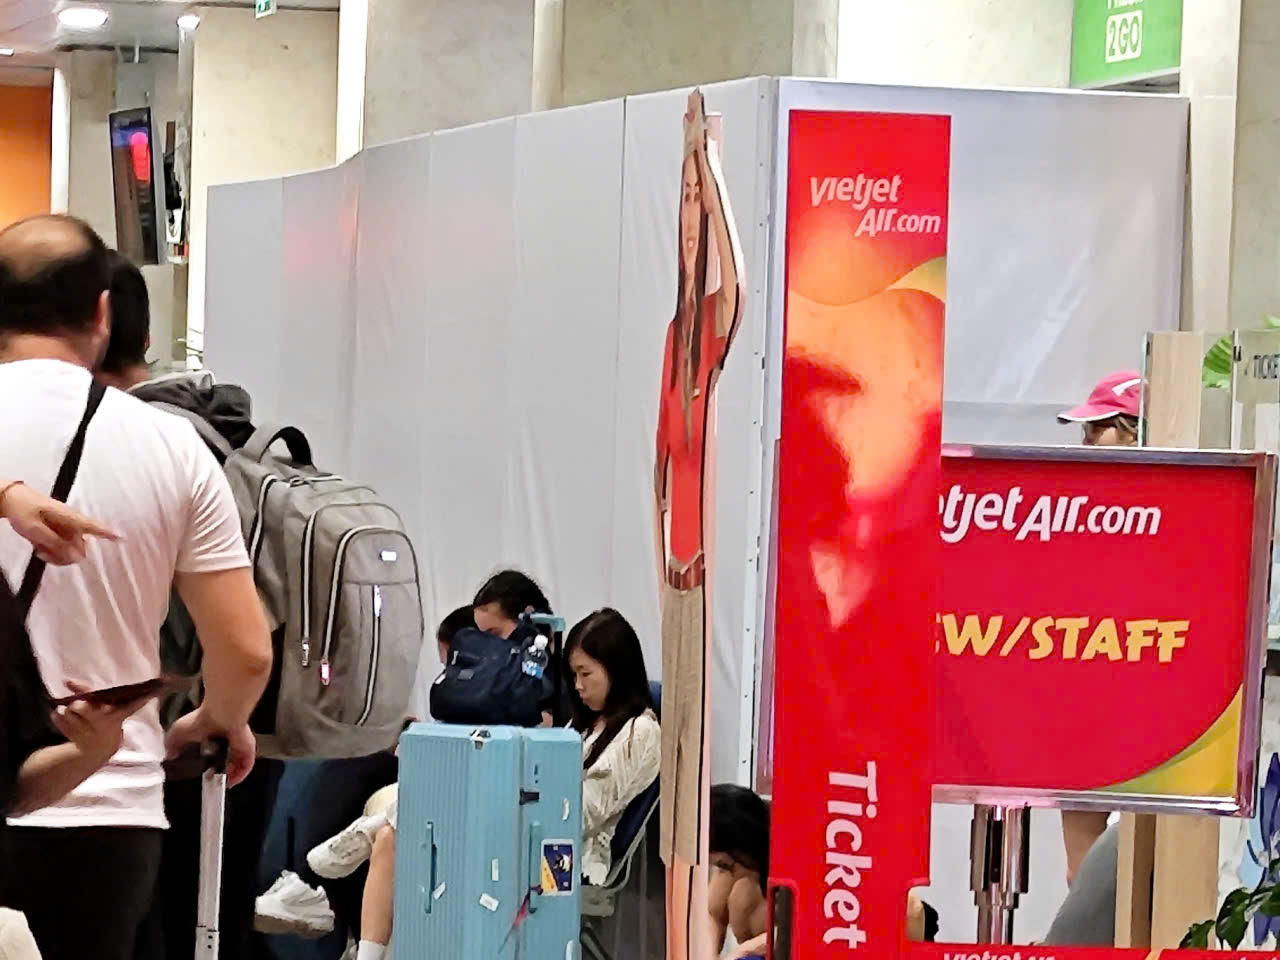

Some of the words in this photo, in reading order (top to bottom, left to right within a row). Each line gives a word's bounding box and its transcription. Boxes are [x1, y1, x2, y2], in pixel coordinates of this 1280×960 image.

[1107, 15, 1140, 57] 2GO
[935, 612, 1191, 663] W/STAFF
[822, 760, 878, 949] Ticket
